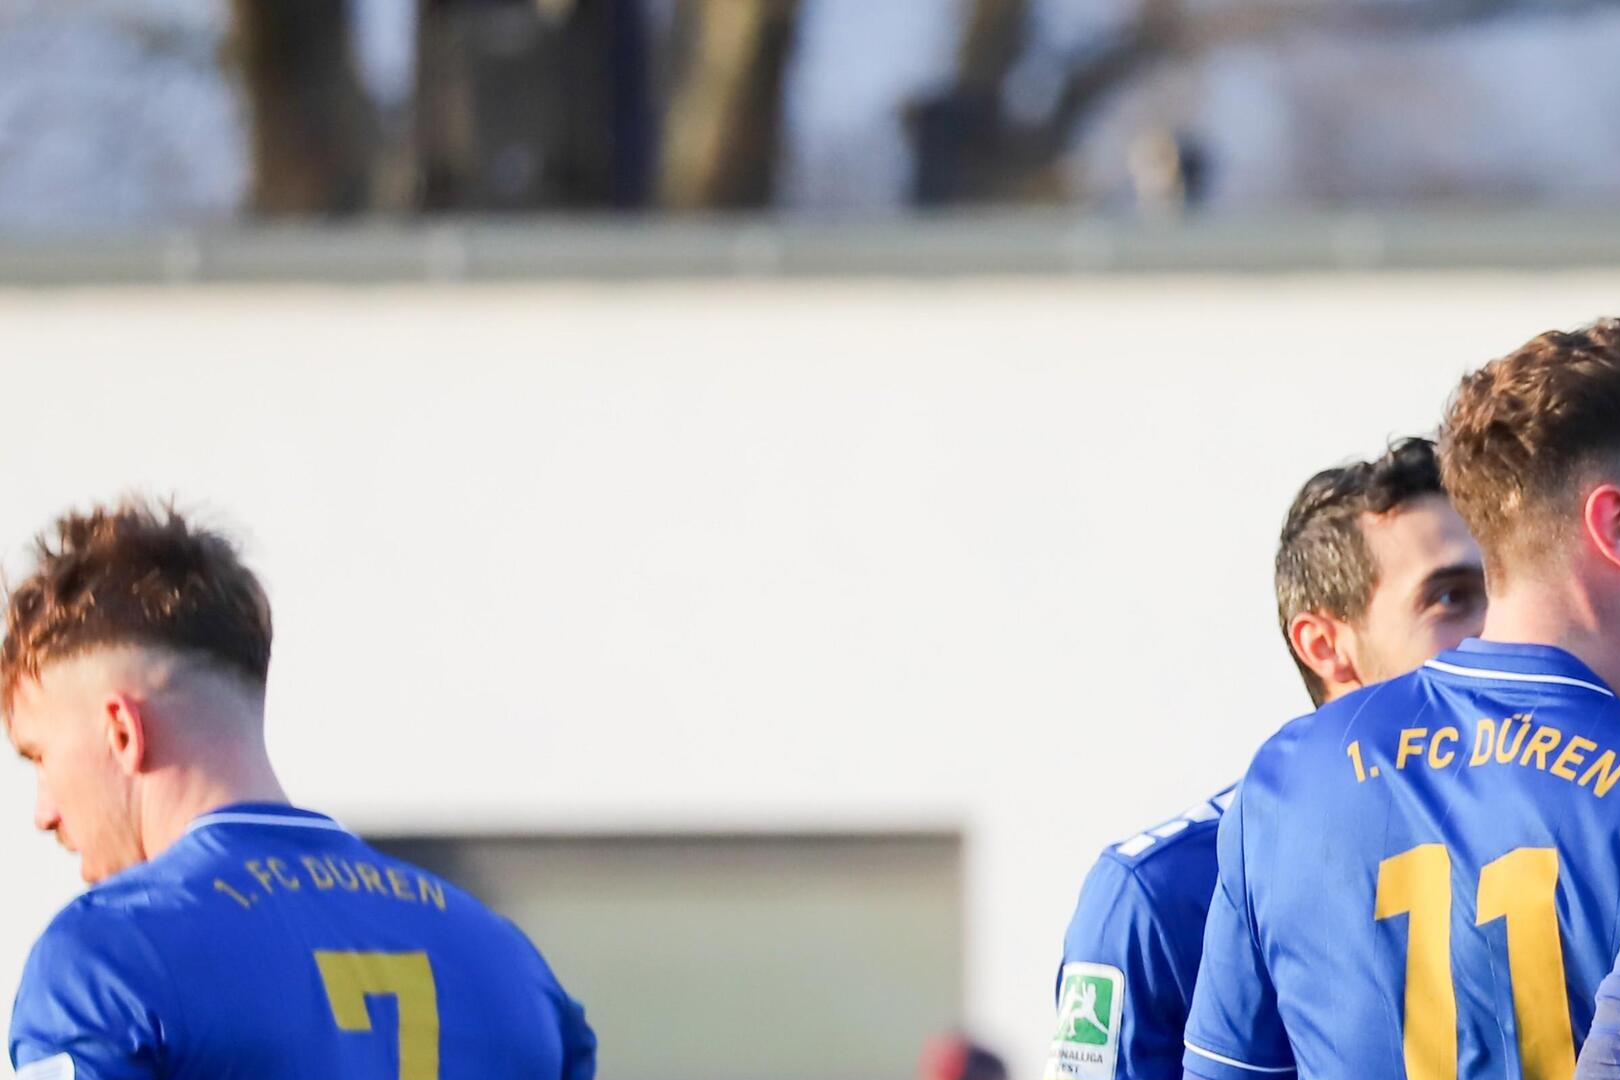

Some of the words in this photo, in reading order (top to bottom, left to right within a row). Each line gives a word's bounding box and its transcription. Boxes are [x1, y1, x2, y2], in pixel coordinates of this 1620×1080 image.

[1347, 740, 1379, 783] 1.
[1396, 726, 1459, 770] FC
[245, 857, 300, 893] FC
